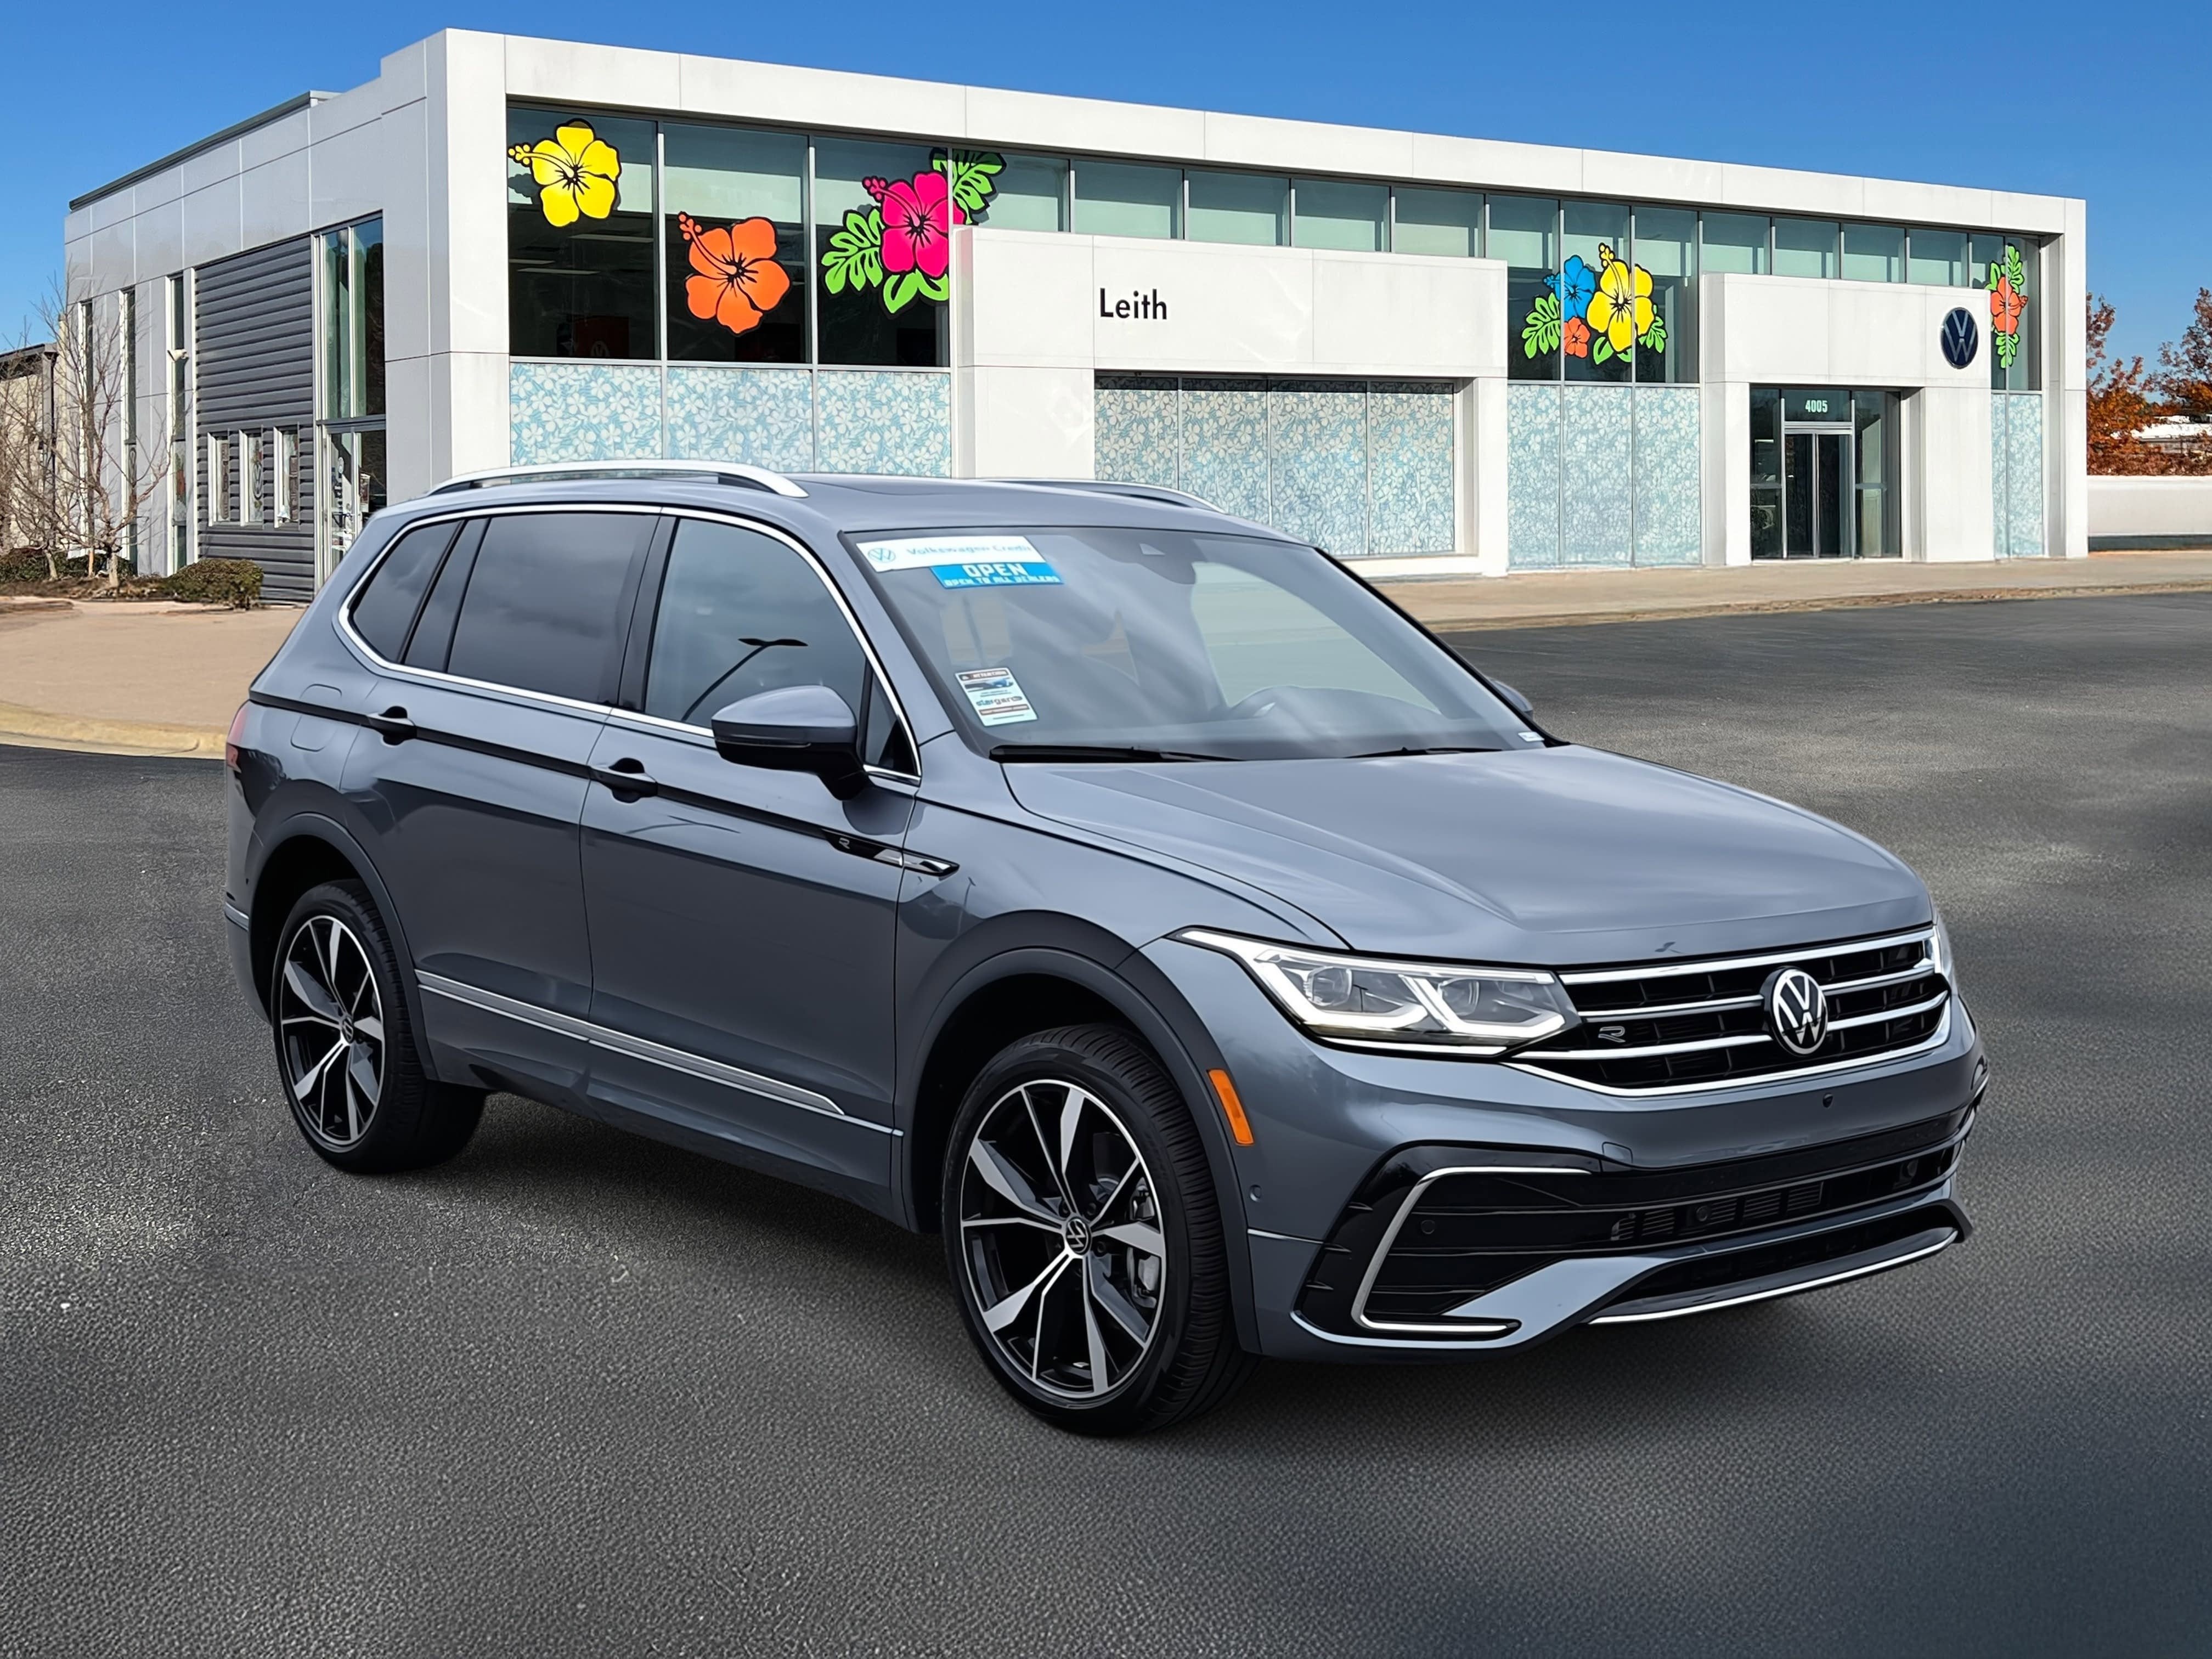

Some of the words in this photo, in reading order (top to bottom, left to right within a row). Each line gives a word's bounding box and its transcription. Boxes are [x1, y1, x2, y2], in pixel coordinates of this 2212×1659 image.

[1099, 287, 1167, 320] Leith
[1940, 306, 1979, 370] VW
[1805, 399, 1828, 413] 4005
[961, 562, 1029, 578] OPEN
[1773, 968, 1828, 1055] VW
[1598, 1025, 1626, 1043] R
